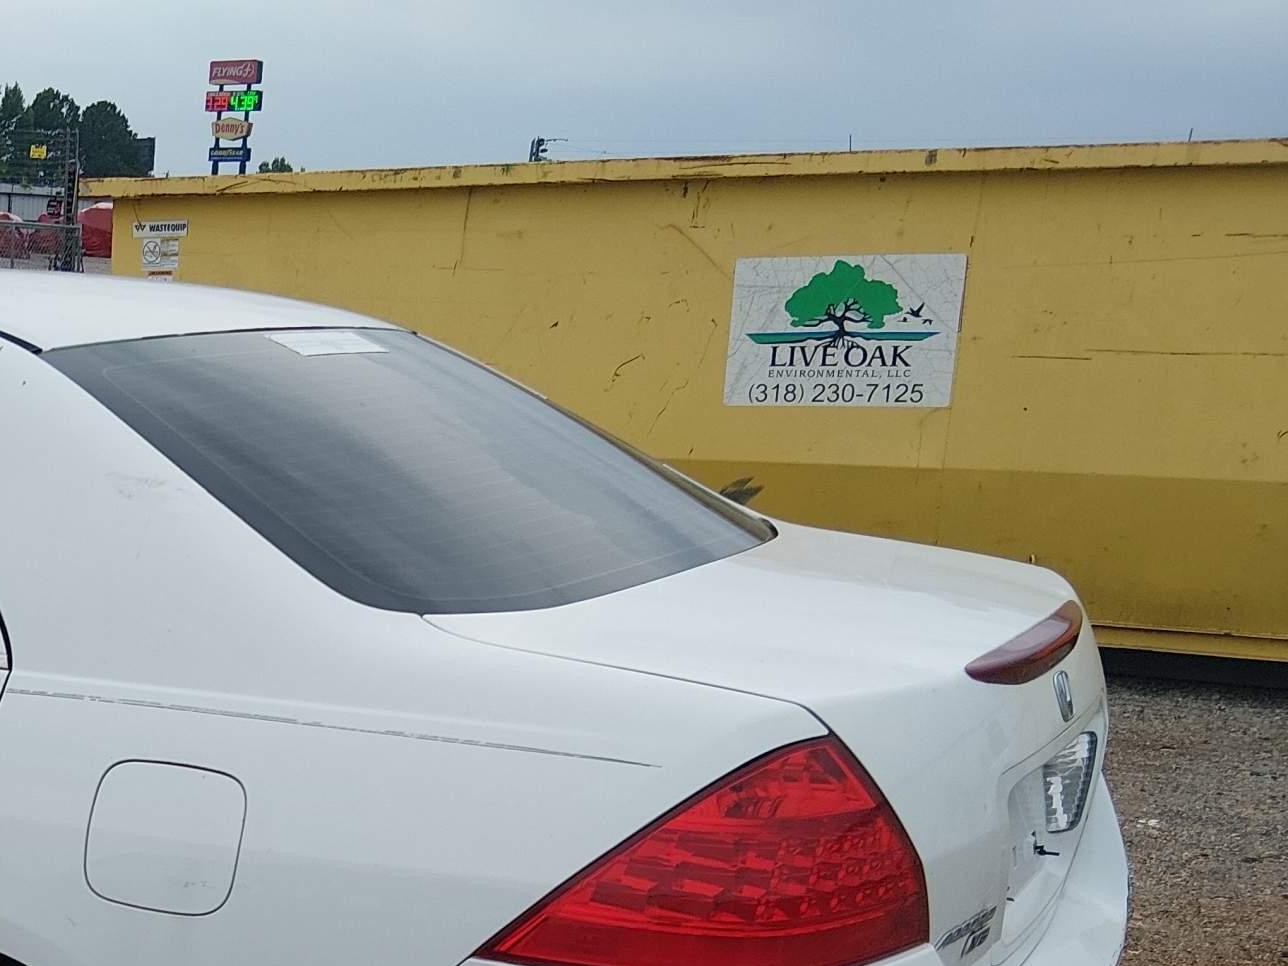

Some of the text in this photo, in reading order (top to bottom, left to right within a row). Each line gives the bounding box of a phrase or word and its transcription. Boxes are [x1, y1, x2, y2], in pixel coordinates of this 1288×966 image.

[212, 65, 243, 77] FLYING
[215, 122, 244, 135] Denny's
[149, 223, 187, 233] WASTEQUIP
[769, 345, 912, 367] LIVE OAK
[768, 369, 911, 378] ENVIRONMENTAL, LLC
[748, 383, 924, 403] (318) 230-7125
